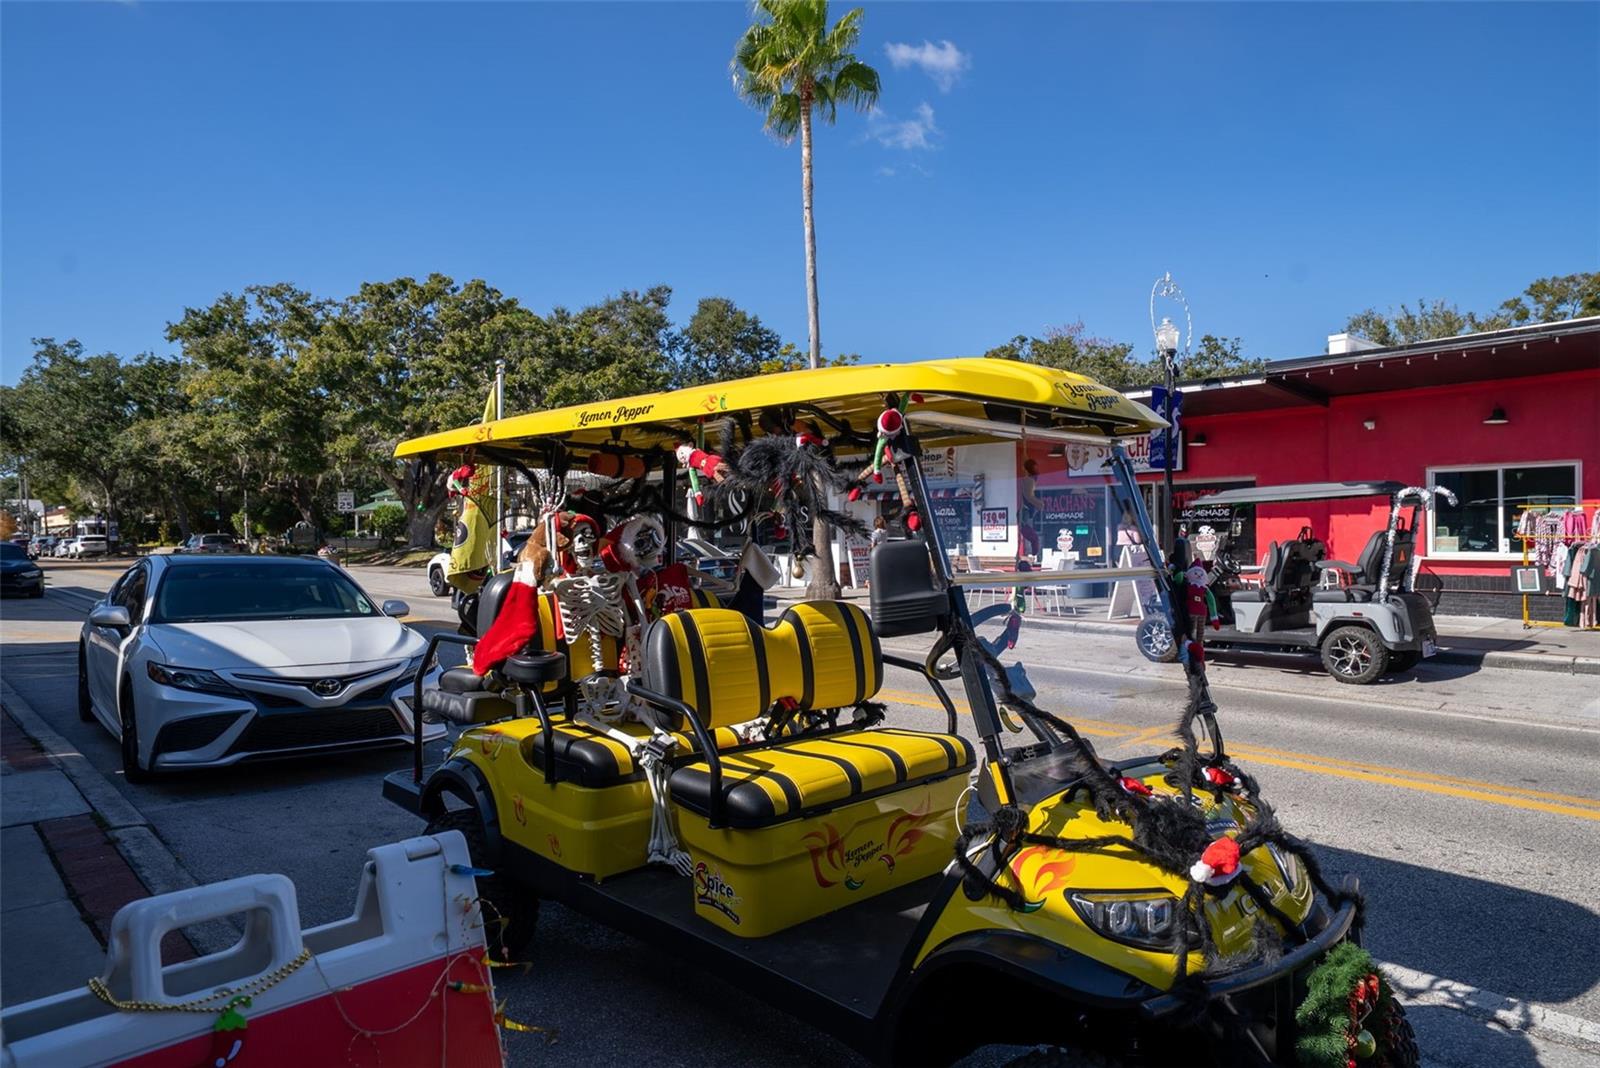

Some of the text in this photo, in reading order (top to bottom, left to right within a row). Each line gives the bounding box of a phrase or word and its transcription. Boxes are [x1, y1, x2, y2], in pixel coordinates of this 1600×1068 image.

[1085, 393, 1120, 411] Pepper
[577, 404, 654, 427] Lemon Pepper
[339, 501, 353, 510] 25
[1045, 511, 1084, 520] HOMEMADE
[1181, 508, 1230, 517] HOMEMADE
[845, 840, 874, 863] Lemon
[854, 842, 885, 868] Pepper
[695, 862, 735, 898] Spice
